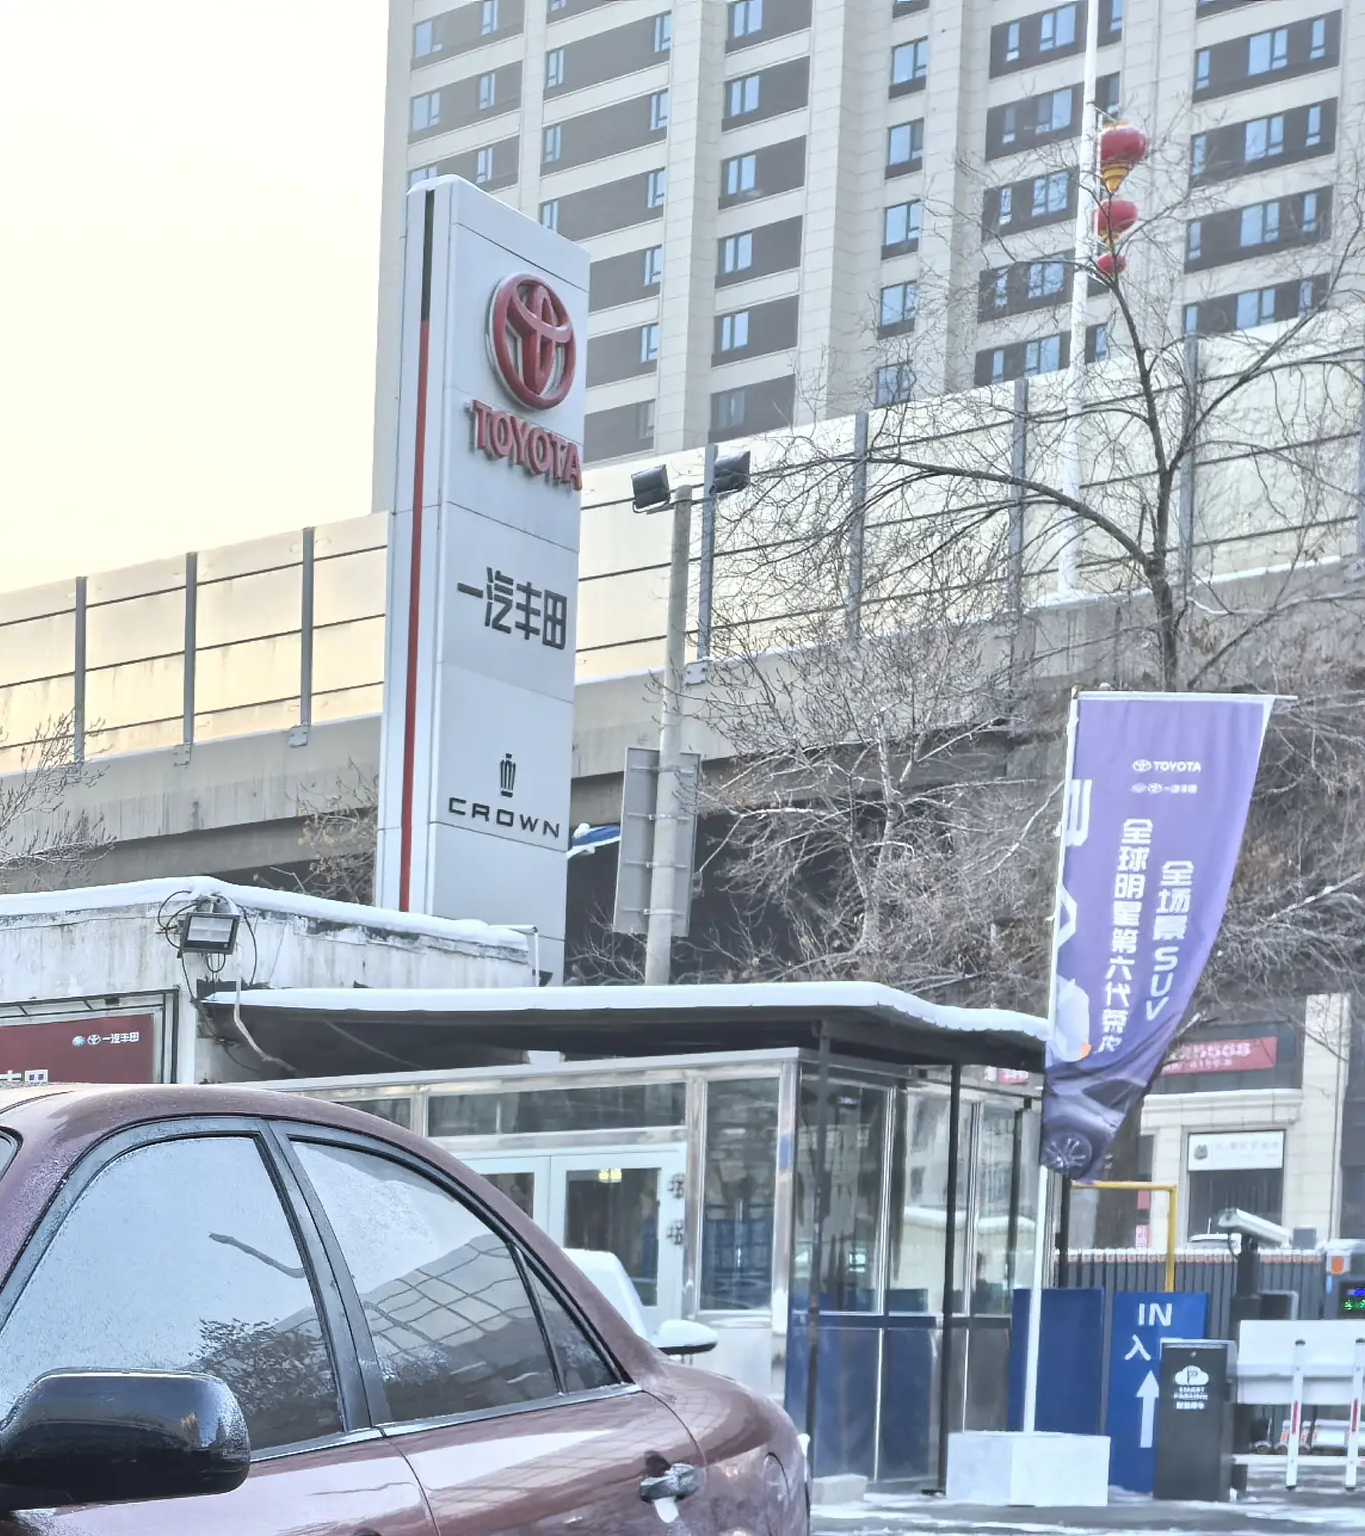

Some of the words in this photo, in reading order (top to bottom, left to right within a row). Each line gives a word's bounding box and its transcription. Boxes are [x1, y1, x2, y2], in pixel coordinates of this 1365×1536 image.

[471, 401, 583, 491] TOYOTA
[457, 566, 567, 651] 一汽丰田
[1152, 760, 1202, 772] TOYOTA
[447, 797, 561, 839] CROWN
[101, 1031, 140, 1045] 一汽丰田
[1137, 1303, 1173, 1327] IN
